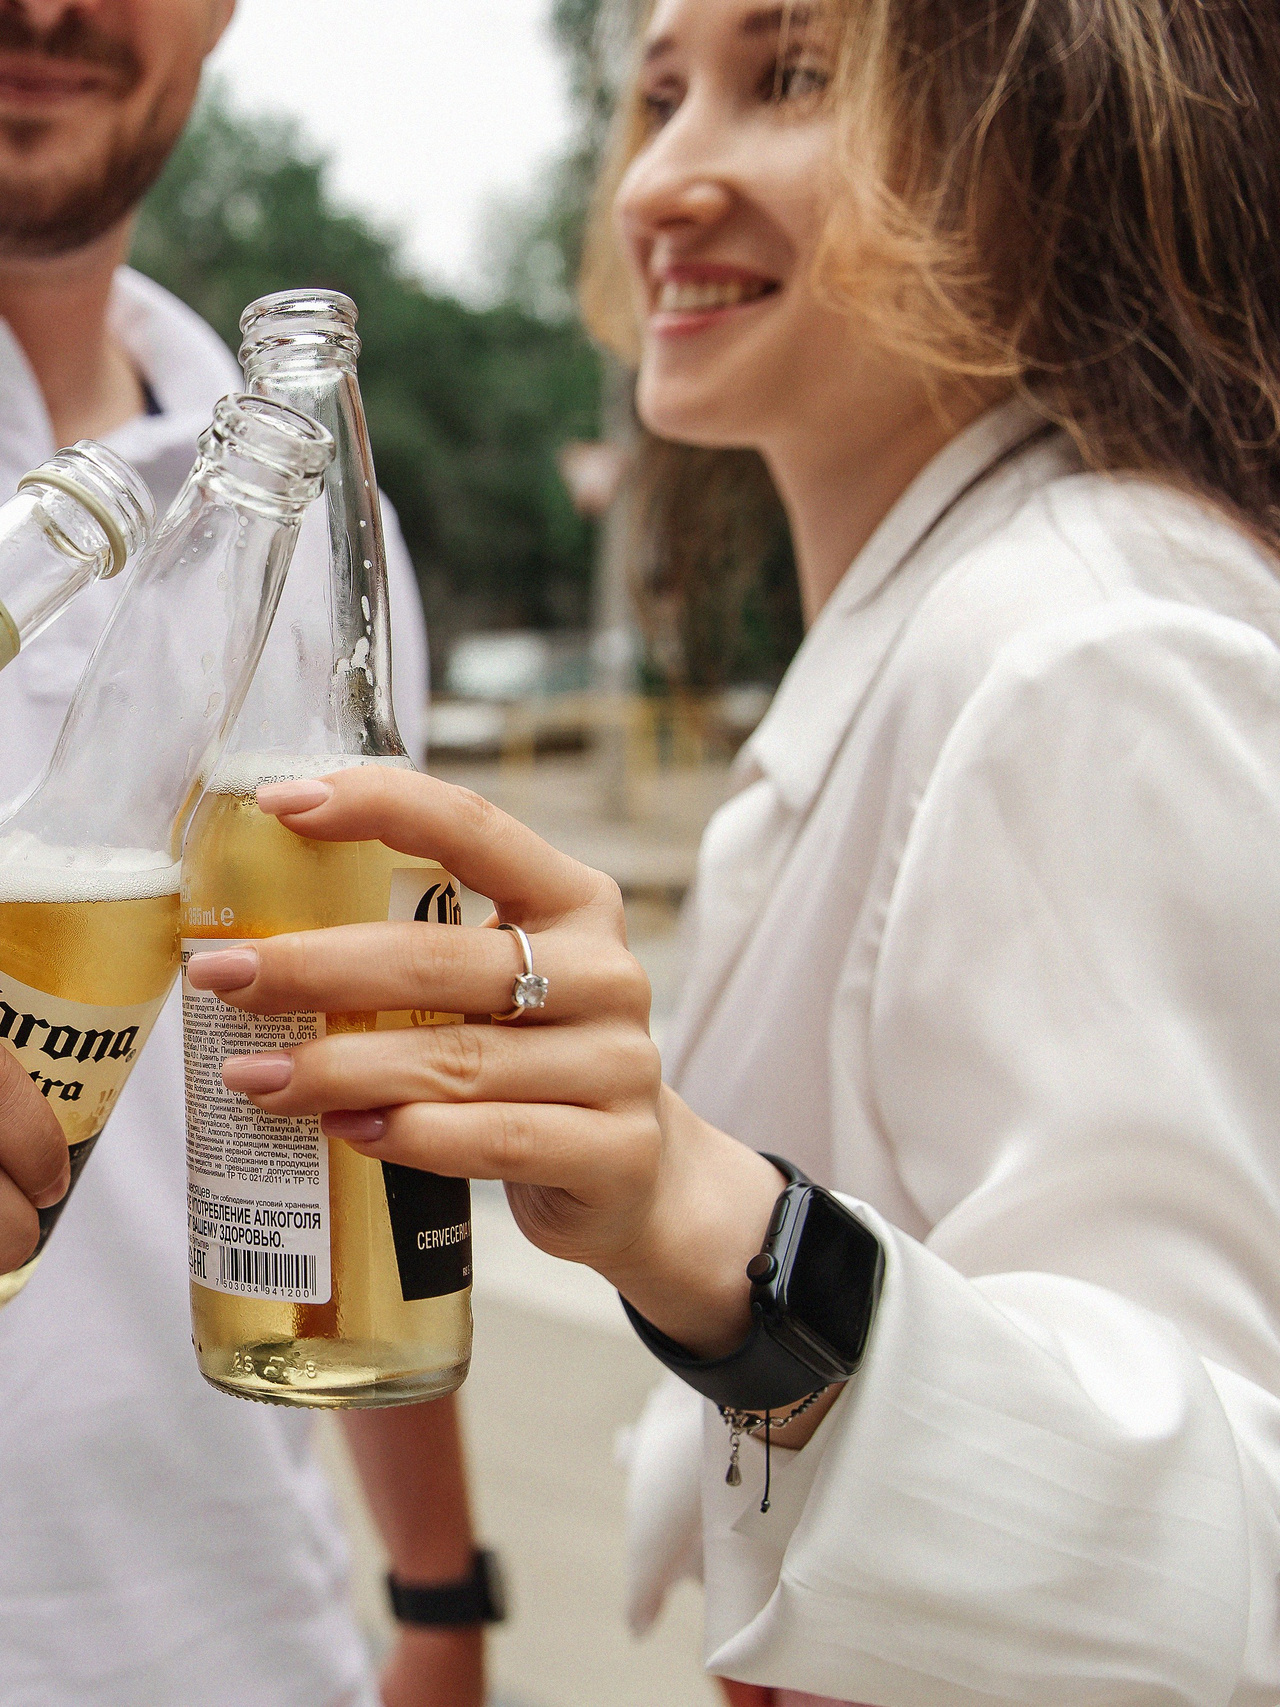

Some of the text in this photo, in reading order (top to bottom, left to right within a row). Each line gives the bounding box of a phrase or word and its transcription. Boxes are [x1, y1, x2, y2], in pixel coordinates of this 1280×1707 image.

[202, 997, 220, 1005] спирта
[219, 1014, 237, 1022] сусла
[215, 1022, 250, 1030] ячменный,
[255, 1024, 293, 1032] кукуруза,
[209, 1030, 251, 1038] аскорбиновая
[255, 1032, 285, 1040] кислота
[289, 1032, 317, 1040] 0,0015
[221, 1038, 277, 1048] Энергетическая
[221, 1046, 250, 1055] Пищевая
[28, 1071, 84, 1101] tra
[210, 1104, 243, 1114] принимать
[228, 1114, 254, 1122] Адыгея
[256, 1115, 293, 1126] (Адыгея),
[208, 1127, 233, 1137] Алкоголь
[233, 1131, 292, 1141] противопоказан
[235, 1123, 248, 1131] аул
[252, 1123, 303, 1134] Тахтамукай,
[308, 1127, 319, 1135] ул
[233, 1140, 269, 1149] кормящим
[272, 1142, 319, 1151] женщинам,
[225, 1147, 252, 1156] нервной
[254, 1150, 290, 1159] системы,
[293, 1152, 319, 1160] почек,
[225, 1154, 268, 1165] Содержание
[276, 1160, 320, 1169] продукции
[224, 1164, 263, 1174] превышает
[267, 1168, 320, 1177] допустимого
[227, 1170, 236, 1179] ТР
[237, 1172, 248, 1181] ТС
[249, 1173, 282, 1184] 021/2011
[293, 1176, 305, 1184] ТР
[307, 1177, 320, 1185] ТС
[220, 1195, 254, 1206] соблюдении
[255, 1200, 282, 1208] условий
[284, 1202, 321, 1210] хранения.
[191, 1195, 251, 1225] УПОТРЕБЛЕНИЕ
[254, 1209, 321, 1230] АЛКОГОЛЯ
[192, 1215, 218, 1239] ВАШЕМУ
[219, 1223, 285, 1248] ЗДОРОВЬЮ.
[223, 1280, 259, 1293] 503034
[264, 1286, 310, 1298] 941200
